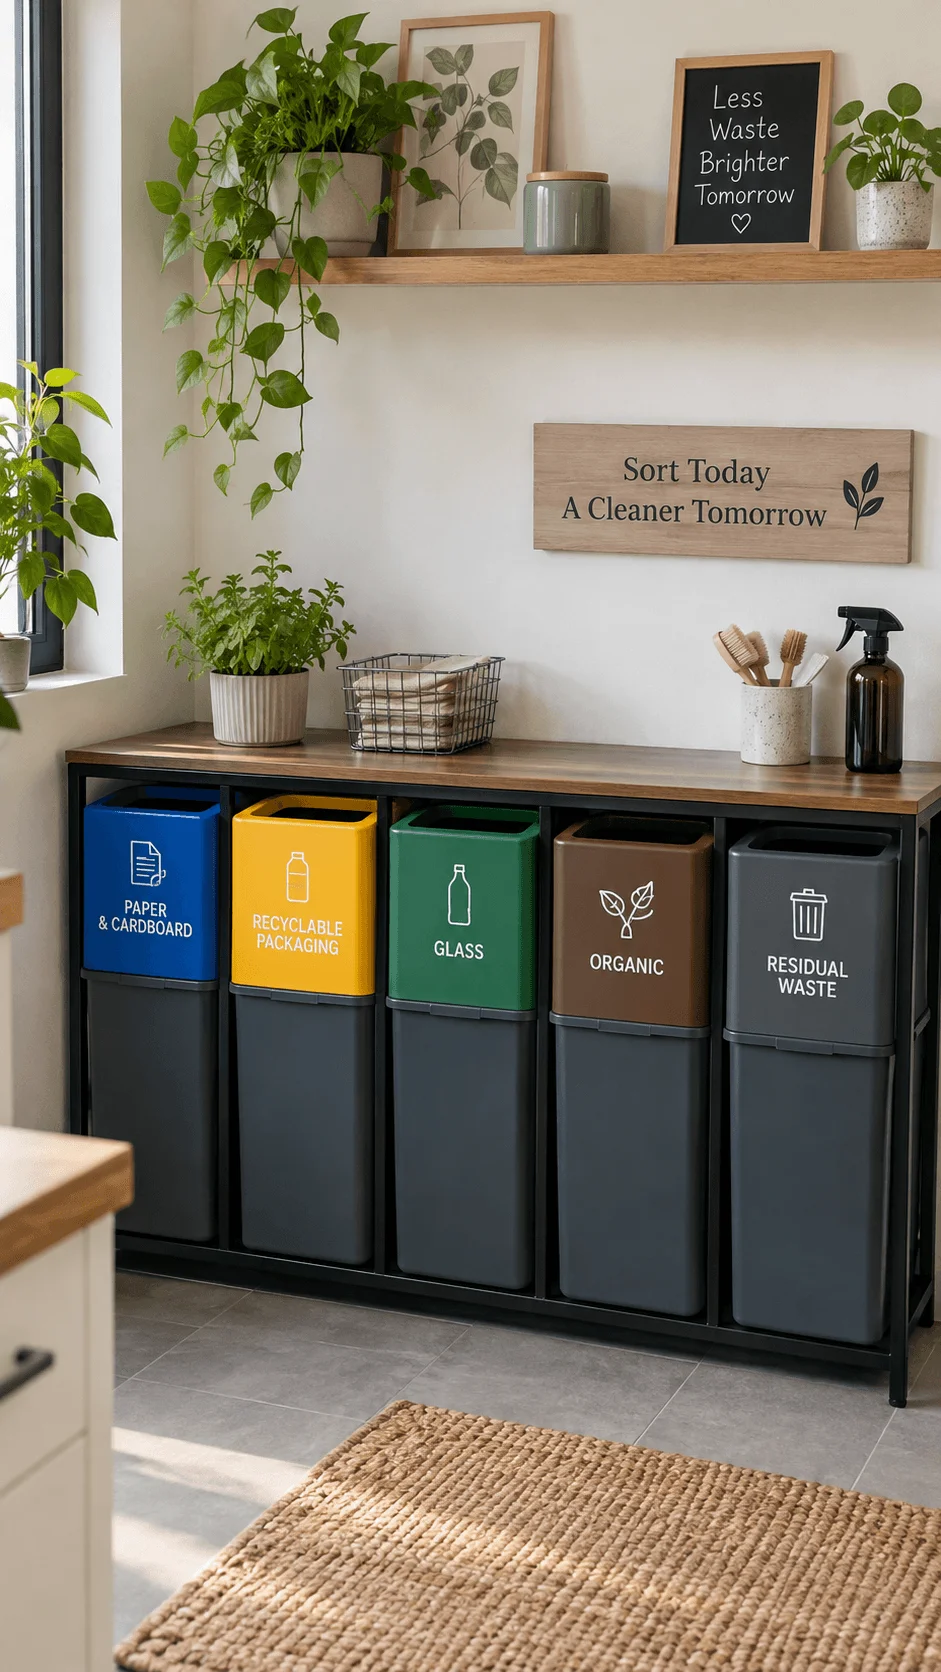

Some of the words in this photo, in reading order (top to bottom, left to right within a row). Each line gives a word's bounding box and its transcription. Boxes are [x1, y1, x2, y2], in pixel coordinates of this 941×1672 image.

[713, 85, 763, 110] Less
[709, 116, 780, 141] Waste
[700, 150, 790, 183] Brighter
[694, 184, 795, 206] Tomorrow
[623, 456, 679, 483] Sort
[688, 458, 771, 491] Today
[561, 497, 582, 520] A
[588, 497, 685, 523] Cleaner
[691, 499, 827, 527] Tomorrow
[124, 899, 167, 919] PAPER
[98, 915, 109, 931] &
[111, 916, 193, 937] CARDBOARD
[253, 914, 343, 938] RECYCLABLE
[257, 933, 340, 956] PACKAGING
[434, 940, 484, 960] GLASS
[589, 953, 664, 976] ORGANIC
[767, 955, 849, 978] RESIDUAL
[778, 977, 838, 999] WASTE
